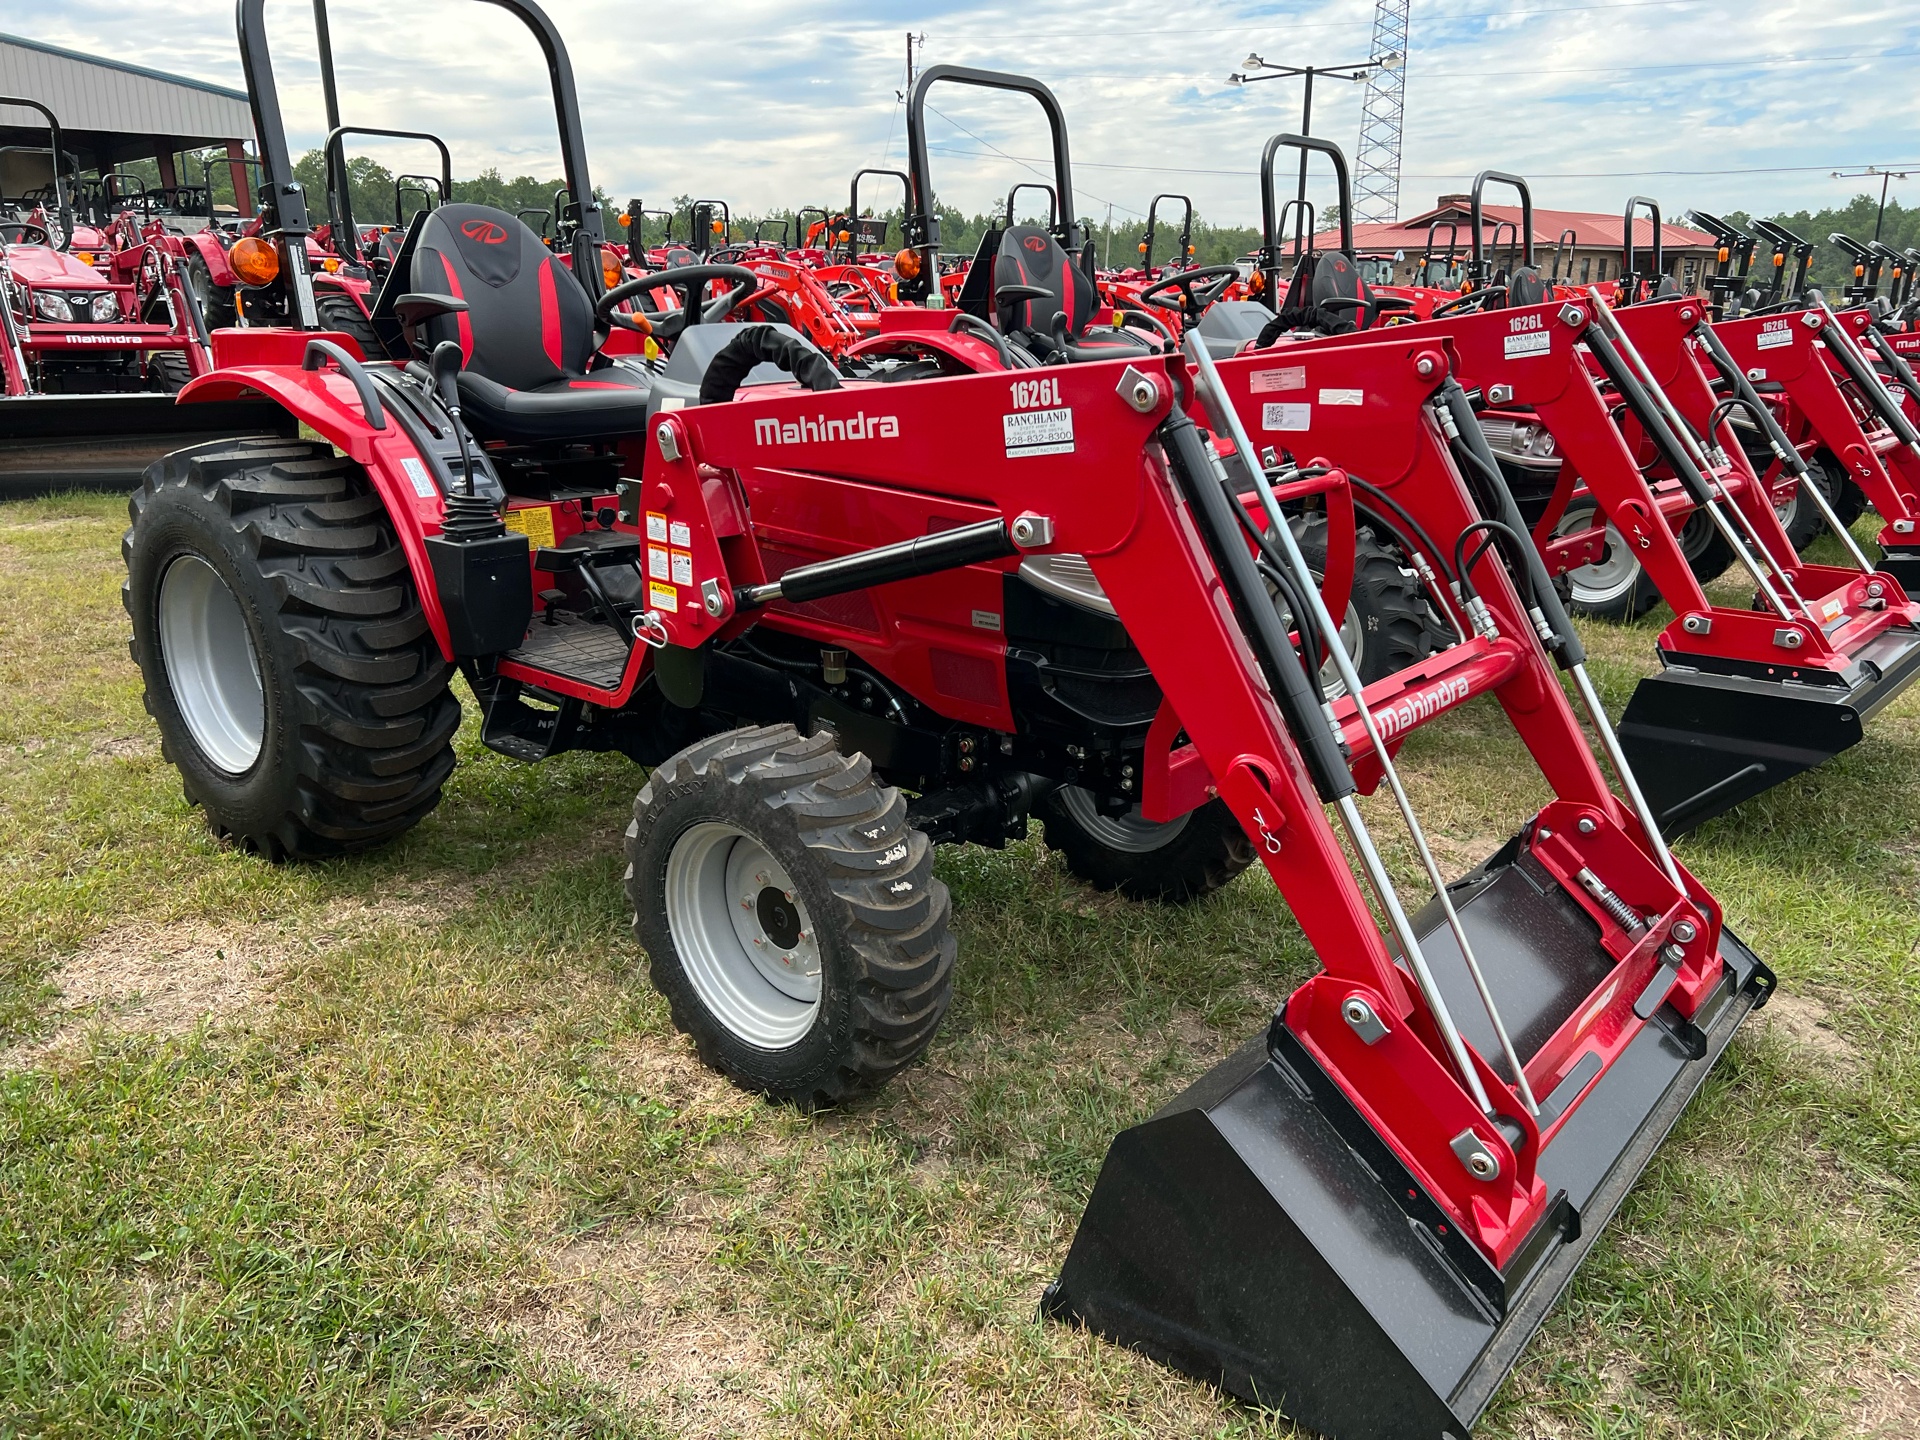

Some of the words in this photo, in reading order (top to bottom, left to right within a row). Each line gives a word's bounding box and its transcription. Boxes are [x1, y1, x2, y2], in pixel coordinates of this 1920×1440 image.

[1509, 313, 1543, 332] 1626L
[1762, 319, 1789, 333] 1626L
[65, 334, 143, 344] Mahindra
[1507, 333, 1547, 343] RANCHLAND
[1009, 377, 1062, 409] 1626L
[1007, 411, 1067, 427] RANCHLAND
[754, 411, 900, 446] Mahindra
[1006, 431, 1072, 445] 228-832-8300
[657, 584, 675, 595] CAUTION
[1374, 676, 1470, 740] Mahindra
[639, 780, 708, 848] GALAXY
